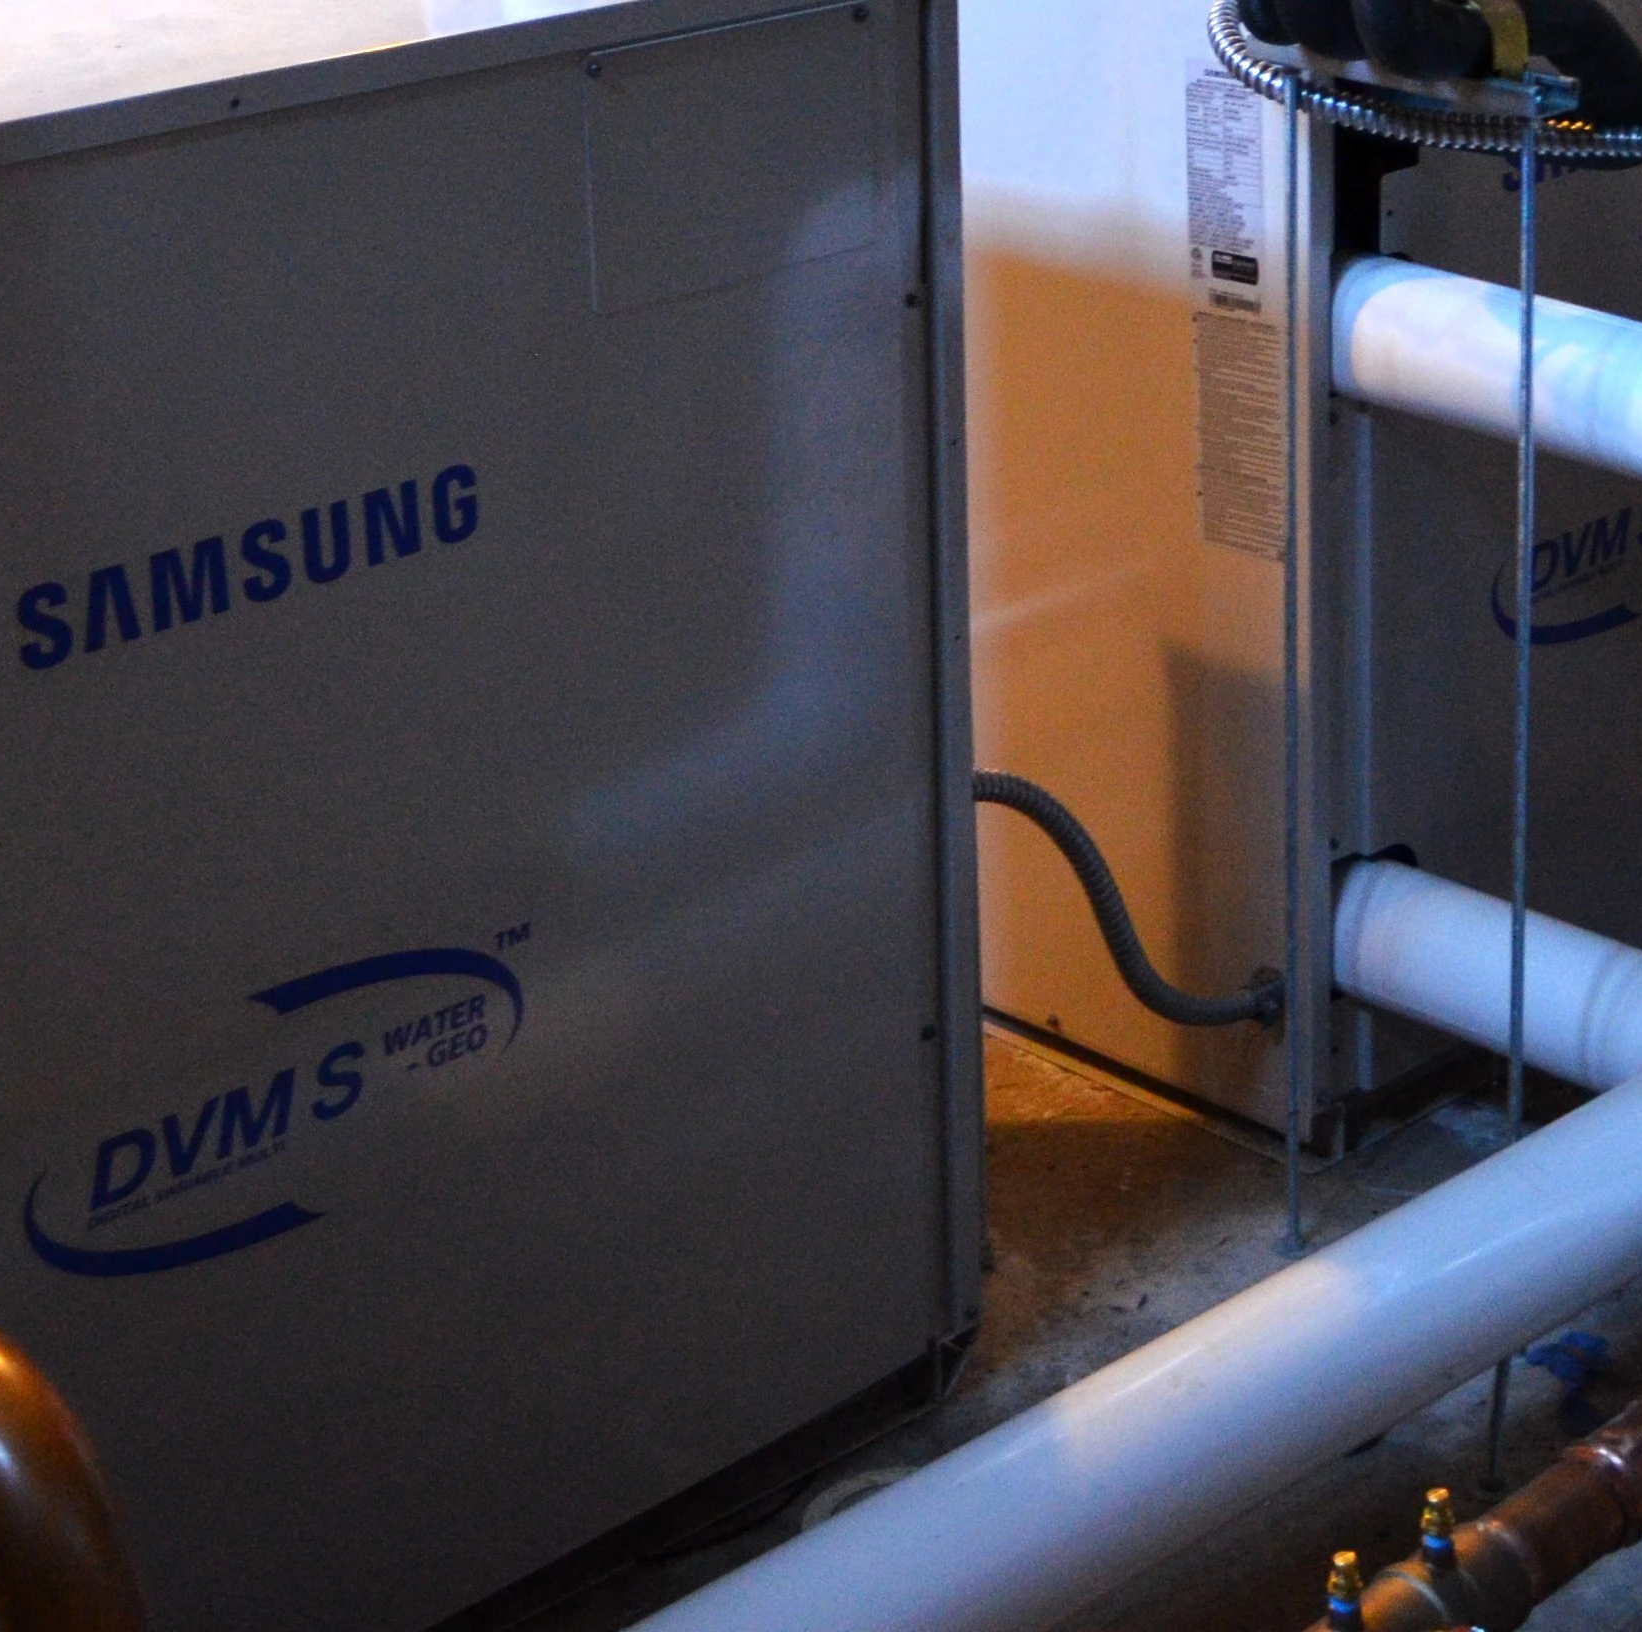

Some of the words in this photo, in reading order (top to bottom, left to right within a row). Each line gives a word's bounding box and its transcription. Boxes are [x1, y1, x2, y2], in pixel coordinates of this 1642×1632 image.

[16, 463, 480, 670] SAMSUNG
[494, 921, 532, 951] TM
[383, 994, 487, 1058] WATER
[88, 1068, 296, 1212] DVM
[312, 1042, 365, 1122] S
